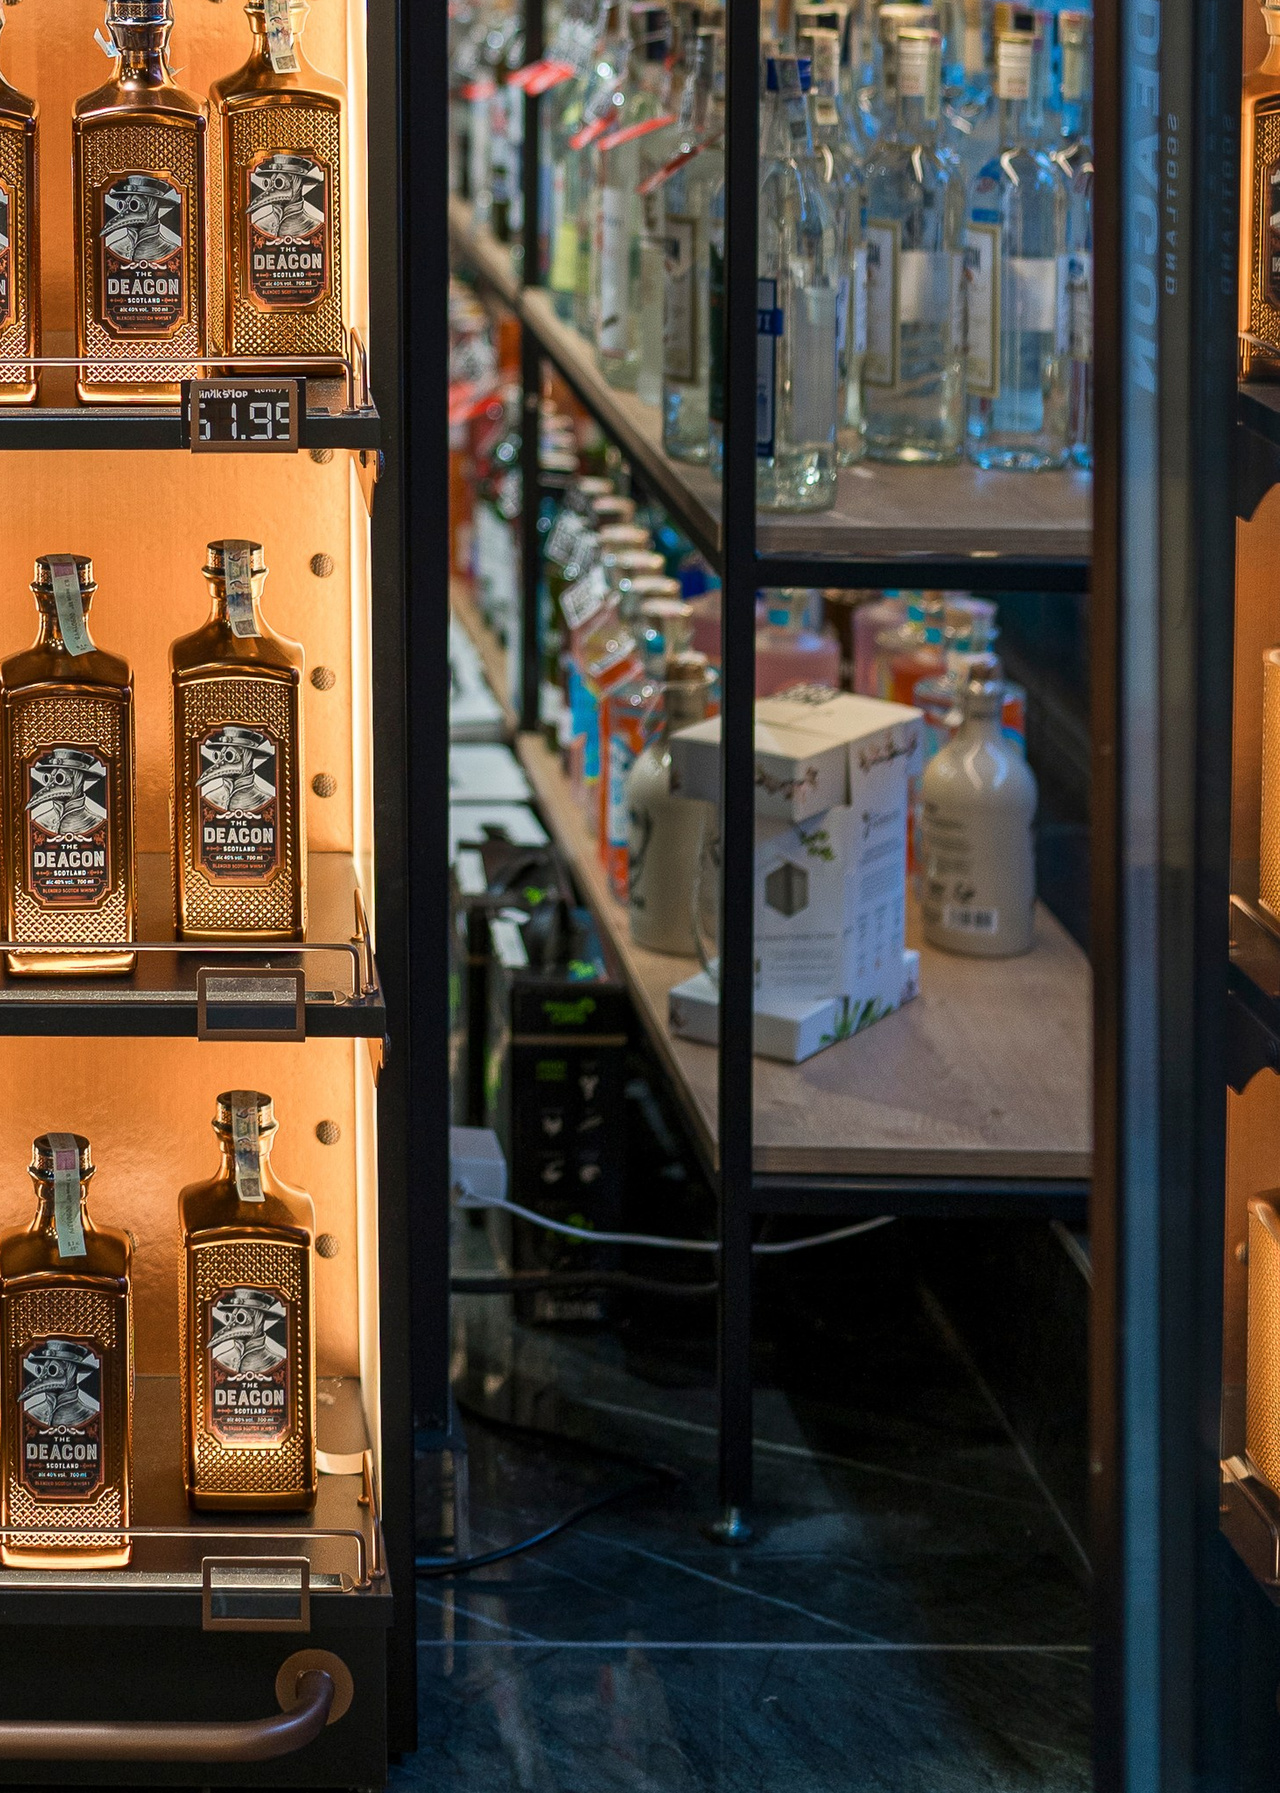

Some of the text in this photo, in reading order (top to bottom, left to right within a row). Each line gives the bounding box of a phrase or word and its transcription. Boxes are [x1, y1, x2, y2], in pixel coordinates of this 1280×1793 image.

[254, 254, 322, 270] DEACON
[108, 278, 179, 295] DEACON
[204, 828, 274, 844] DEACON
[34, 851, 105, 868] DEACON
[215, 1390, 284, 1406] DEACON
[26, 1443, 98, 1460] DEACON
